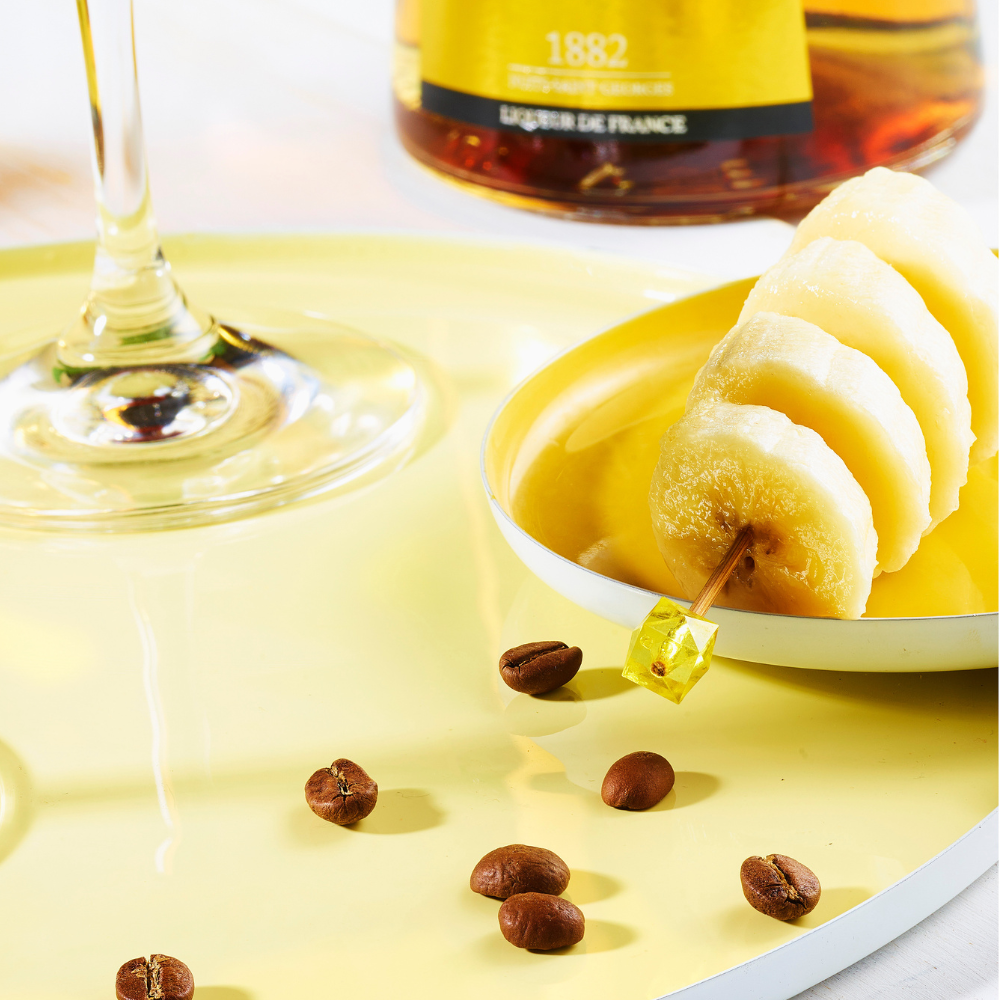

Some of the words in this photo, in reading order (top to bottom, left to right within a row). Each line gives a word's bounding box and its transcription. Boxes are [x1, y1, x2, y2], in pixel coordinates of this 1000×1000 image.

[545, 31, 629, 68] 1882
[577, 112, 607, 133] DE
[608, 114, 688, 135] FRANCE
